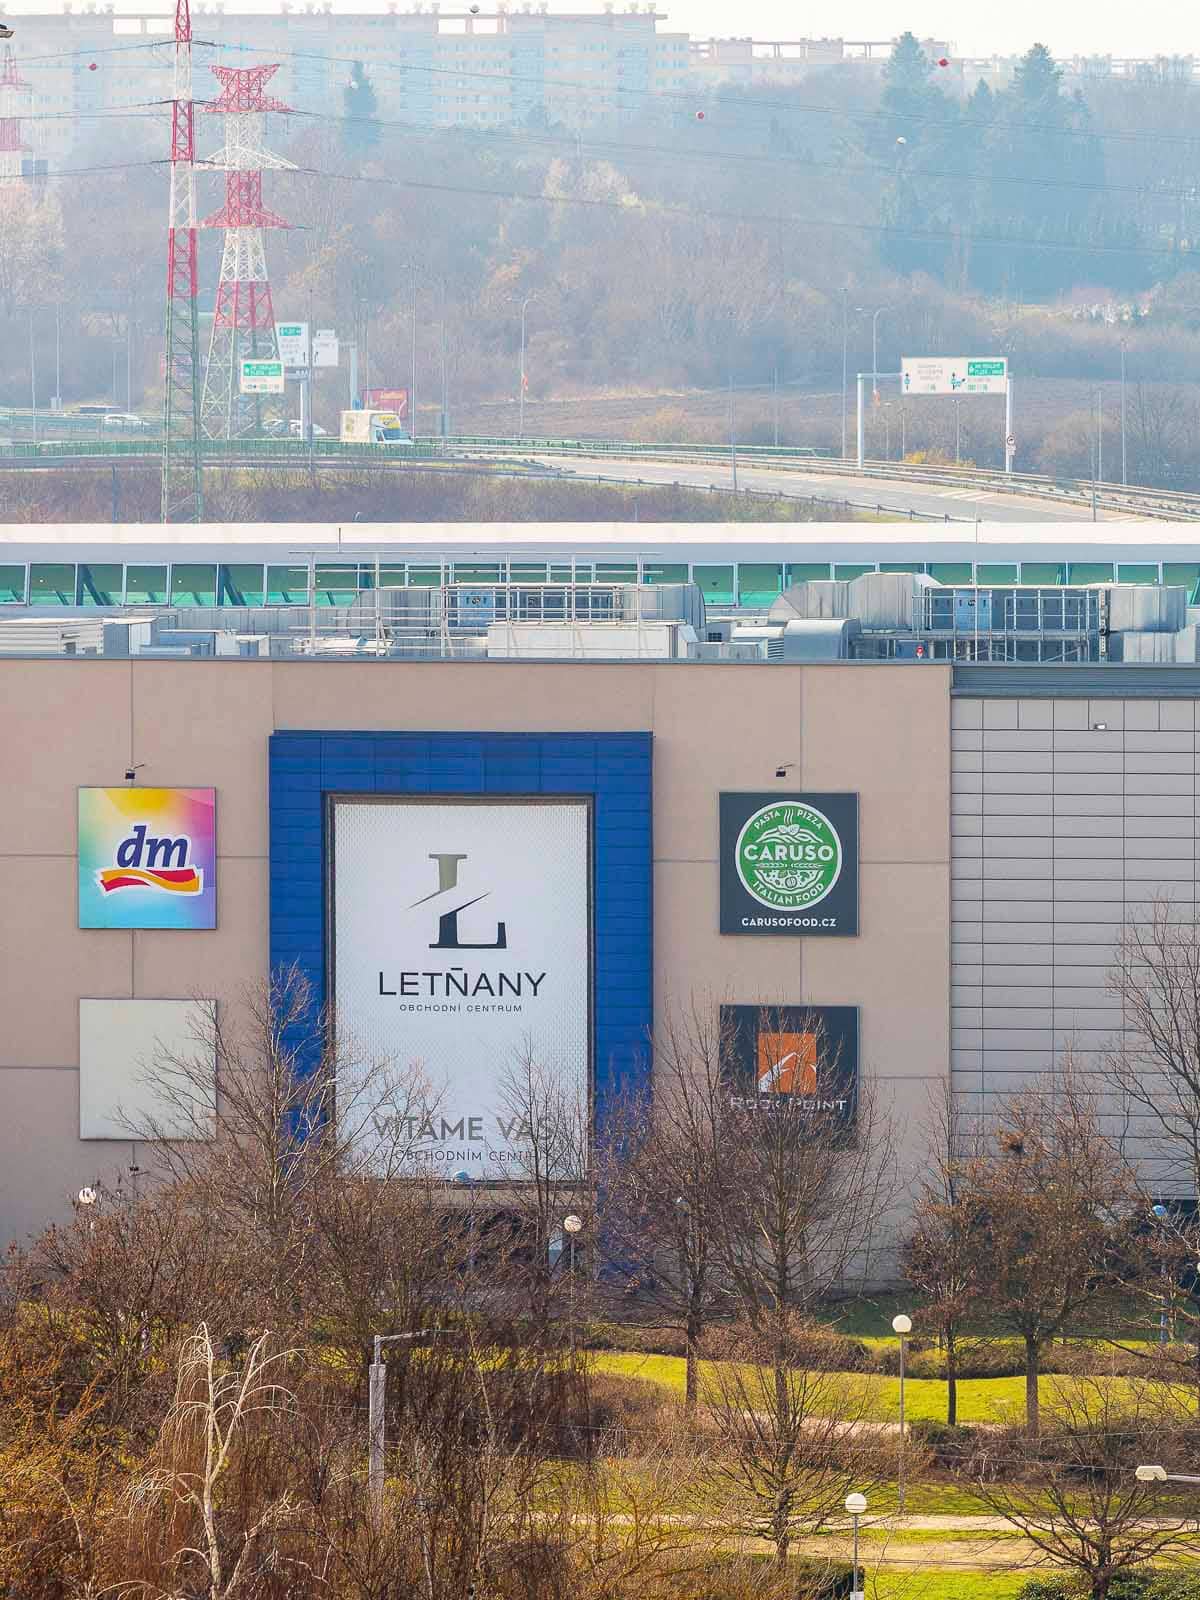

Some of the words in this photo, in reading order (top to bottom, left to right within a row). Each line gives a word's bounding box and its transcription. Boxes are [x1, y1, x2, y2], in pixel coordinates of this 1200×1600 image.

[754, 810, 781, 829] PASTA
[797, 809, 823, 829] PIZZA
[117, 825, 188, 868] dm
[743, 844, 834, 861] CARUSO
[752, 881, 792, 904] ITALIAN
[796, 883, 824, 904] FOOD
[741, 917, 838, 928] CARUSOFOOD.CZ
[400, 1003, 461, 1013] OBCHODNÍ
[466, 1004, 522, 1013] CENTRUM
